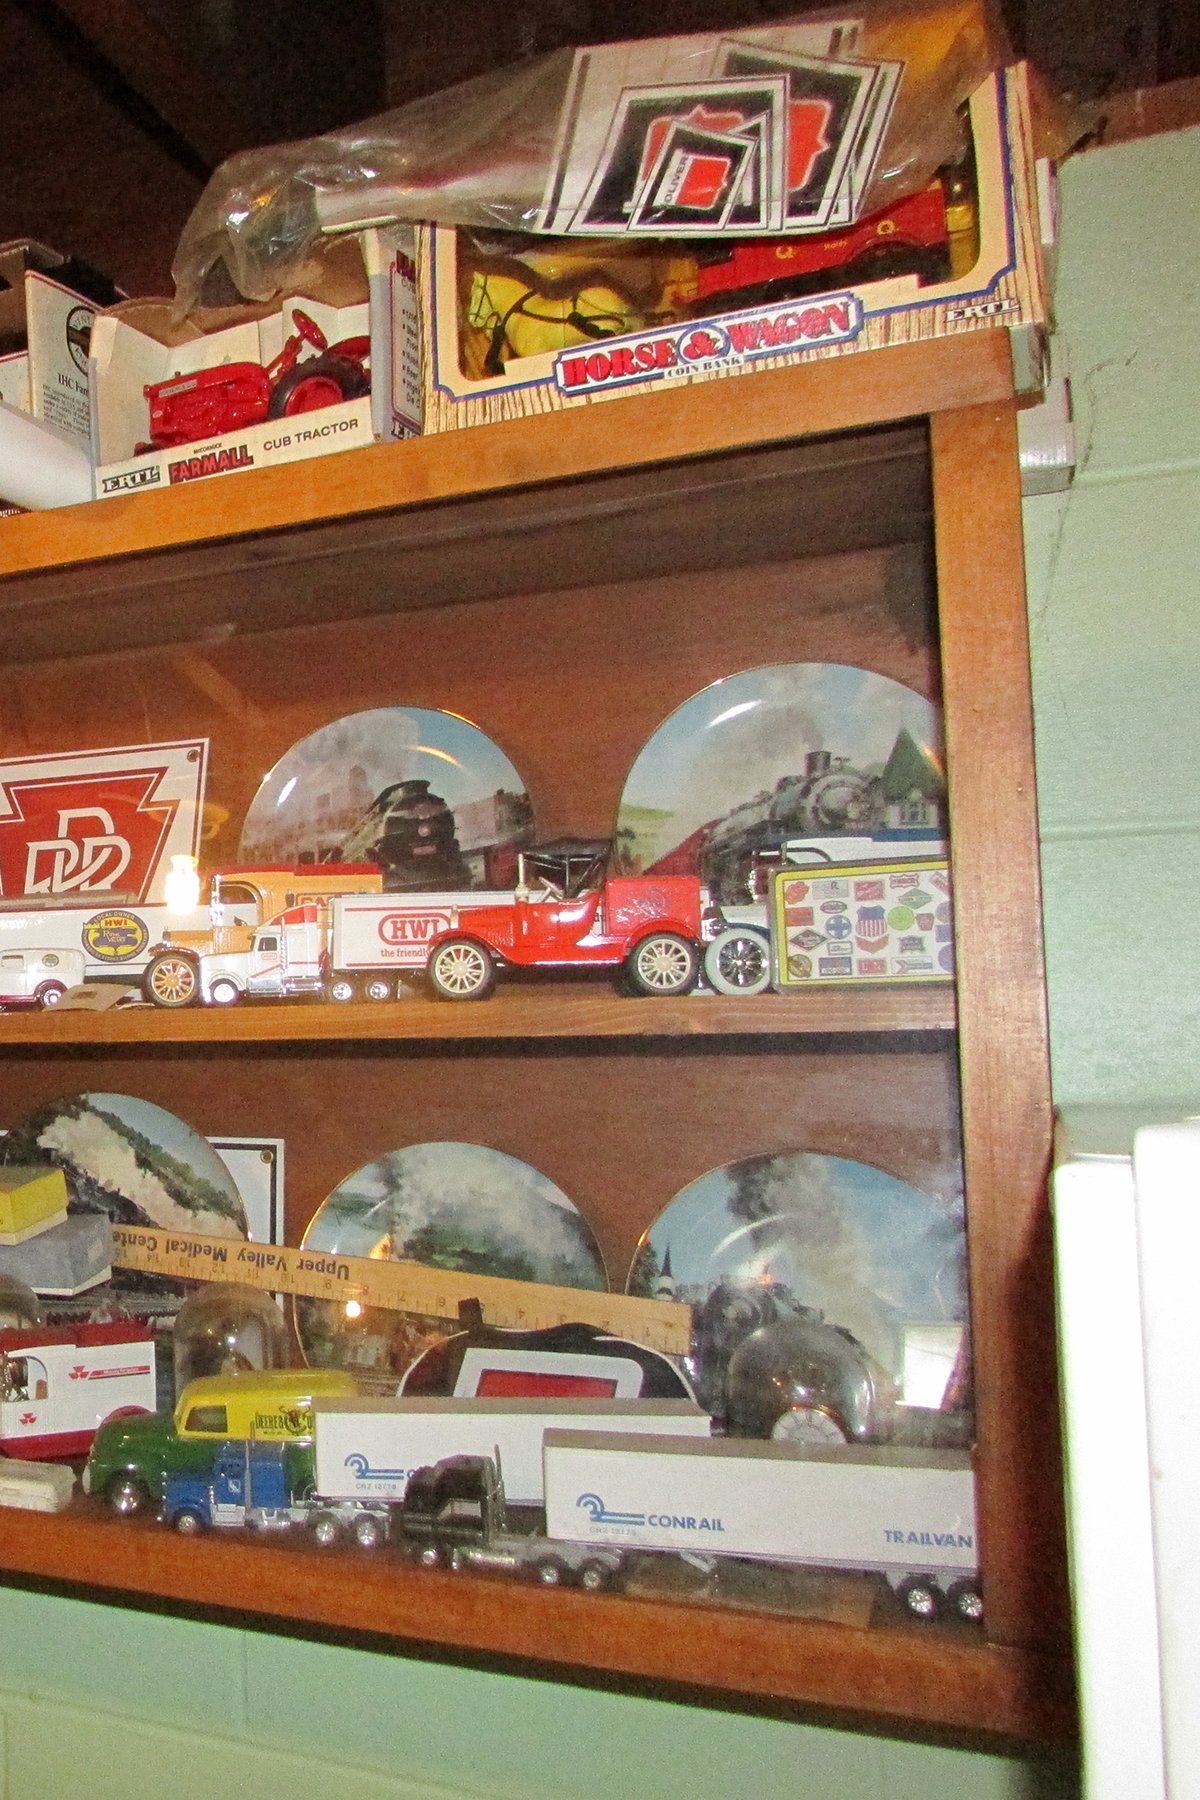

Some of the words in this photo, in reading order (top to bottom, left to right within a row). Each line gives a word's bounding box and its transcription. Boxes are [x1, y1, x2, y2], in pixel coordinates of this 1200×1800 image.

[663, 154, 690, 204] OLIVER
[946, 299, 1021, 323] ERTL
[561, 336, 678, 388] HORSE
[681, 329, 722, 361] &
[726, 300, 853, 355] WAGON
[666, 363, 700, 379] COIN
[702, 356, 742, 372] BANK
[102, 465, 161, 494] ERTL
[167, 444, 255, 485] FARMALL
[262, 436, 292, 452] CUB
[294, 418, 360, 443] TRACTOR
[104, 919, 128, 927] HWI
[390, 918, 441, 940] HWI
[380, 947, 396, 958] the
[396, 947, 431, 960] friendly
[165, 1237, 228, 1263] Medical
[237, 1247, 288, 1272] Valley
[296, 1257, 350, 1281] Upper
[647, 1514, 726, 1532] CONRAIL
[883, 1528, 974, 1549] TRAILVAN
